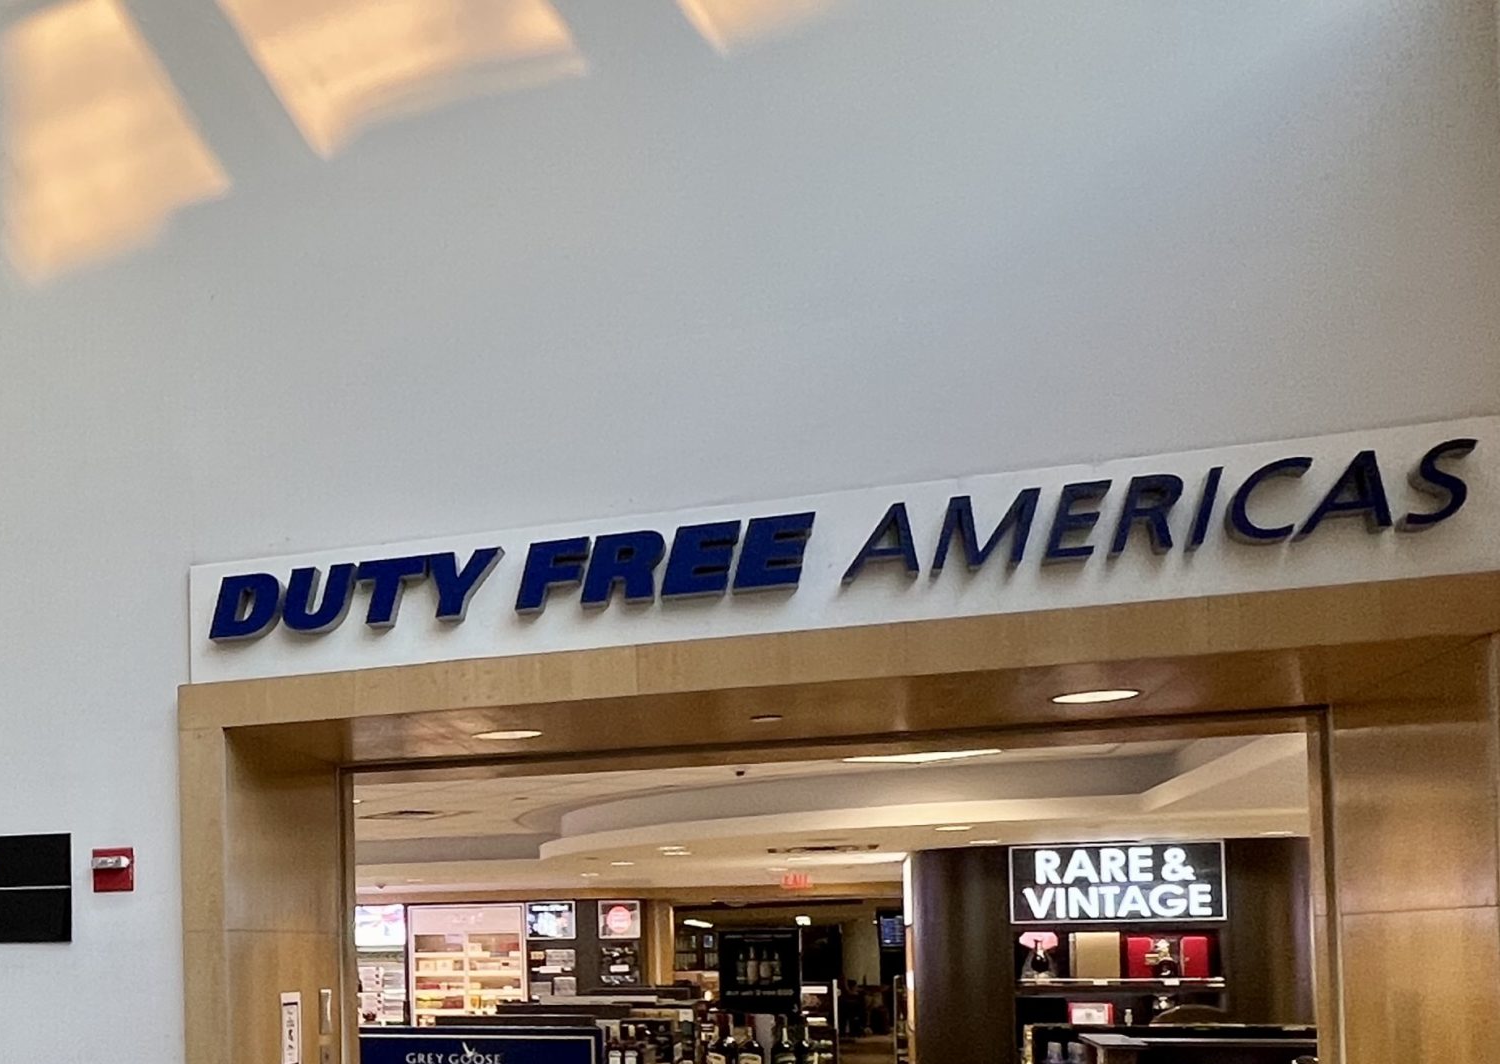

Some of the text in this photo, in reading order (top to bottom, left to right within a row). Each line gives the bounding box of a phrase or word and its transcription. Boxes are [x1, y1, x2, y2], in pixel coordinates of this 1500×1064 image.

[208, 438, 1478, 642] DUTY FREE AMERICAS
[1034, 847, 1196, 885] RARE &
[1022, 883, 1212, 919] VINTAGE
[405, 1052, 444, 1064] GREY
